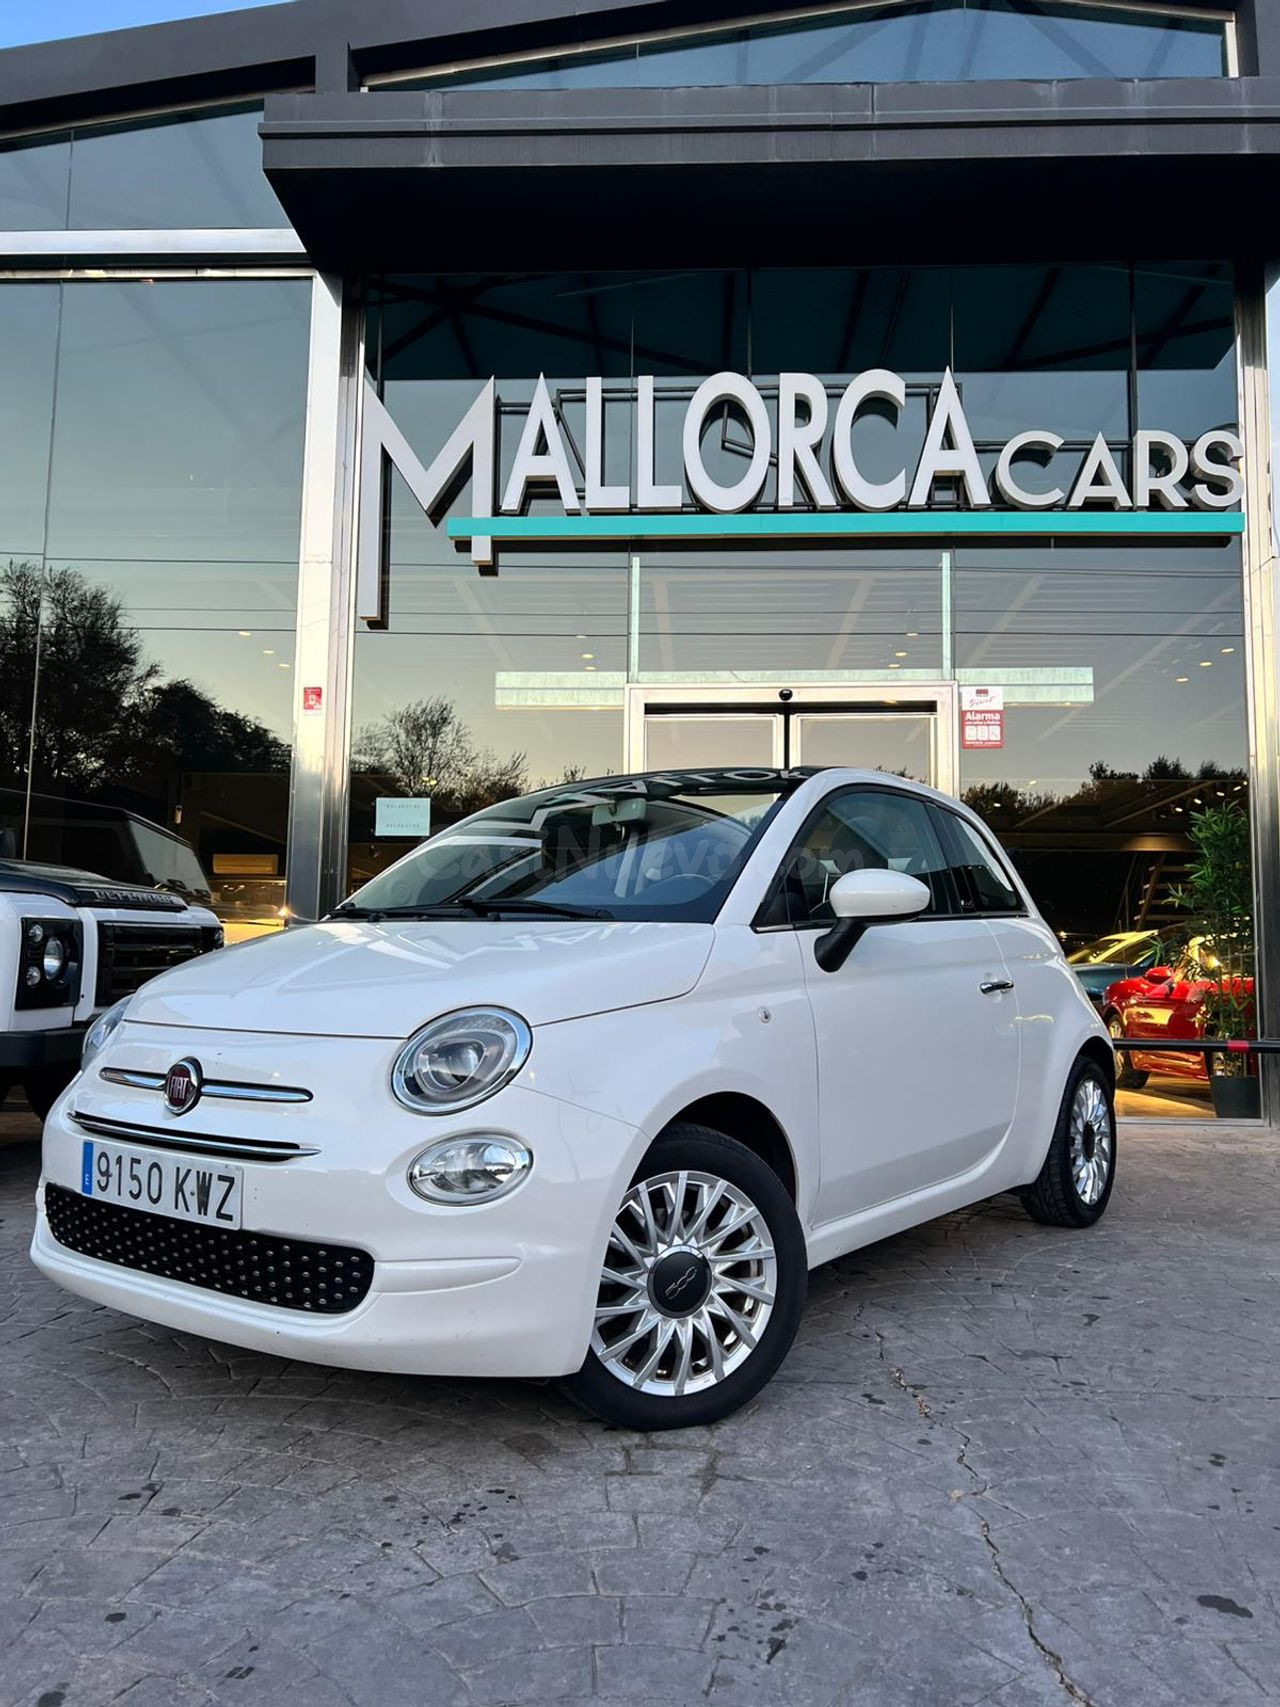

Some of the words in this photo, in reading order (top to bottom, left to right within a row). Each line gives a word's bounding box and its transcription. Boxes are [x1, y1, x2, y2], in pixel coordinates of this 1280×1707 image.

[358, 365, 992, 621] MALLORCA
[995, 429, 1245, 511] CARS
[166, 1075, 190, 1100] FIAT
[97, 1151, 162, 1204] 9150
[174, 1166, 235, 1222] KWZ
